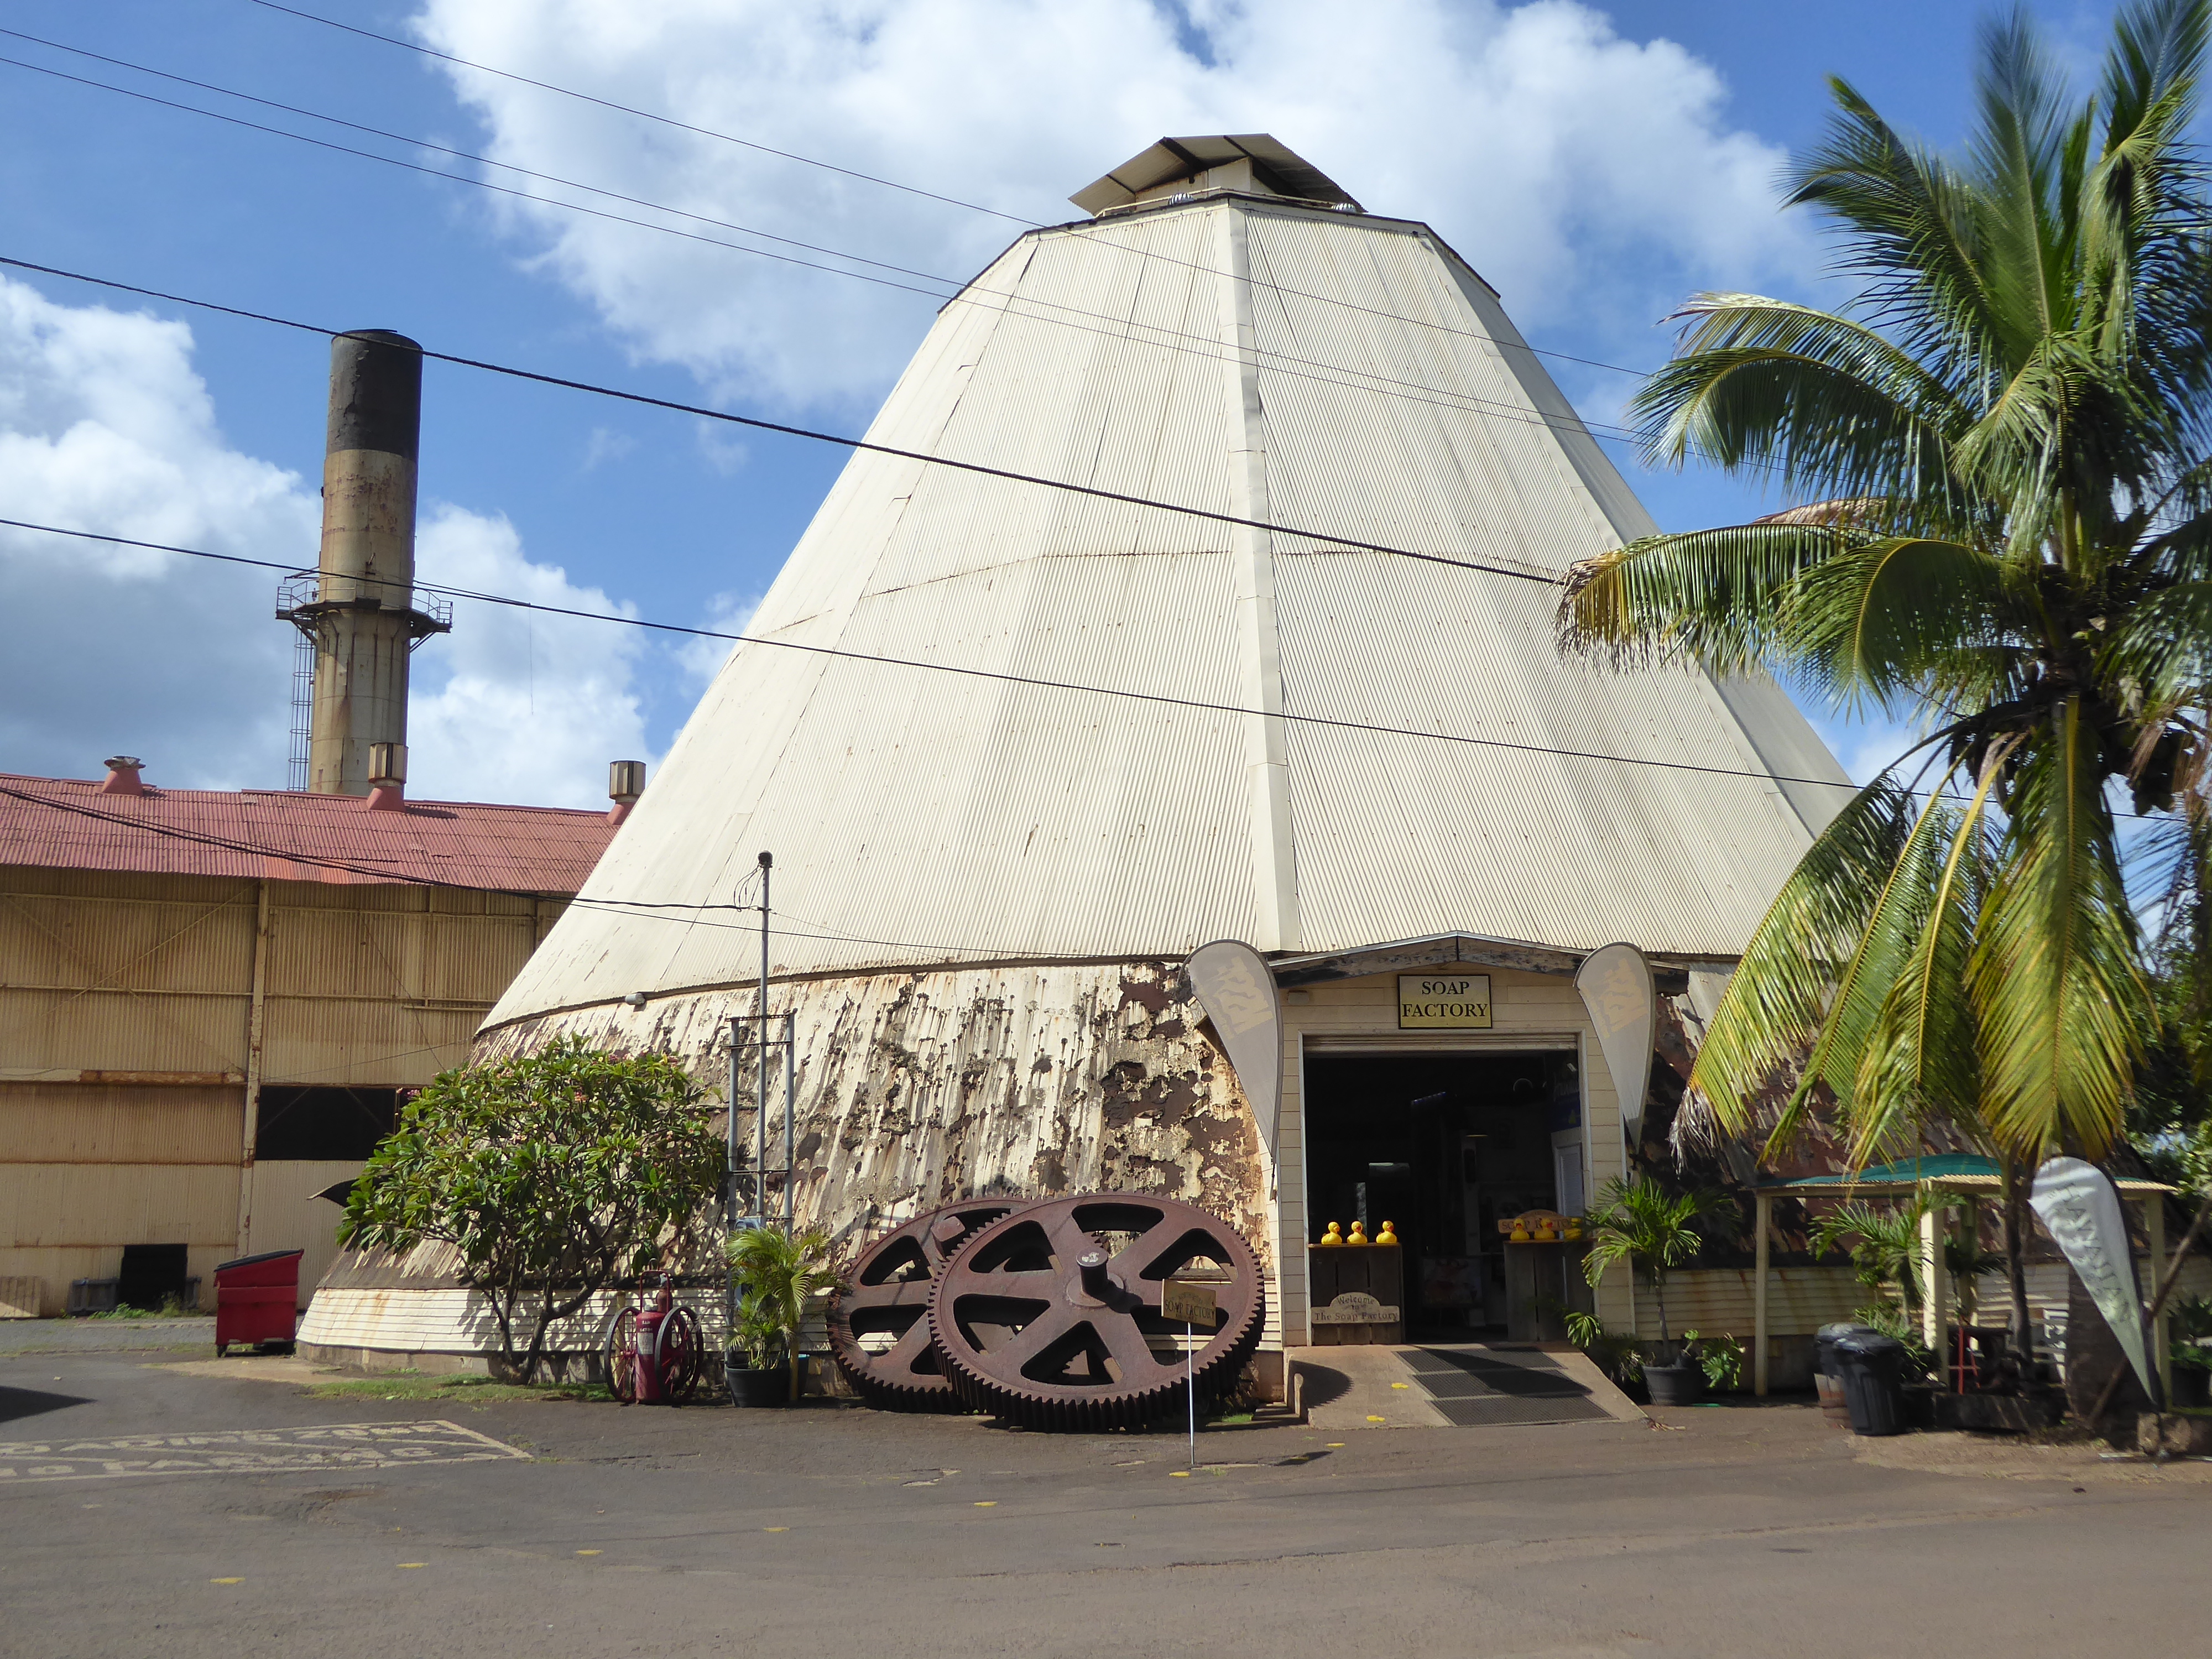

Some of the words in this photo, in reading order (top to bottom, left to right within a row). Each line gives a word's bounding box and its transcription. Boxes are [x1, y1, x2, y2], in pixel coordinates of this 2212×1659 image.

[1422, 981, 1470, 995] SOAP
[1401, 1003, 1488, 1018] FACTORY
[1502, 1220, 1530, 1230] SOP
[1337, 1295, 1374, 1305] Welcome
[1165, 1299, 1183, 1314] SOAP
[1186, 1303, 1215, 1320] FACTORY
[1314, 1312, 1332, 1321] The
[1335, 1312, 1358, 1322] Soap
[1361, 1312, 1399, 1322] Factory
[0, 1432, 282, 1454] OADING
[293, 1425, 447, 1439] ZONE
